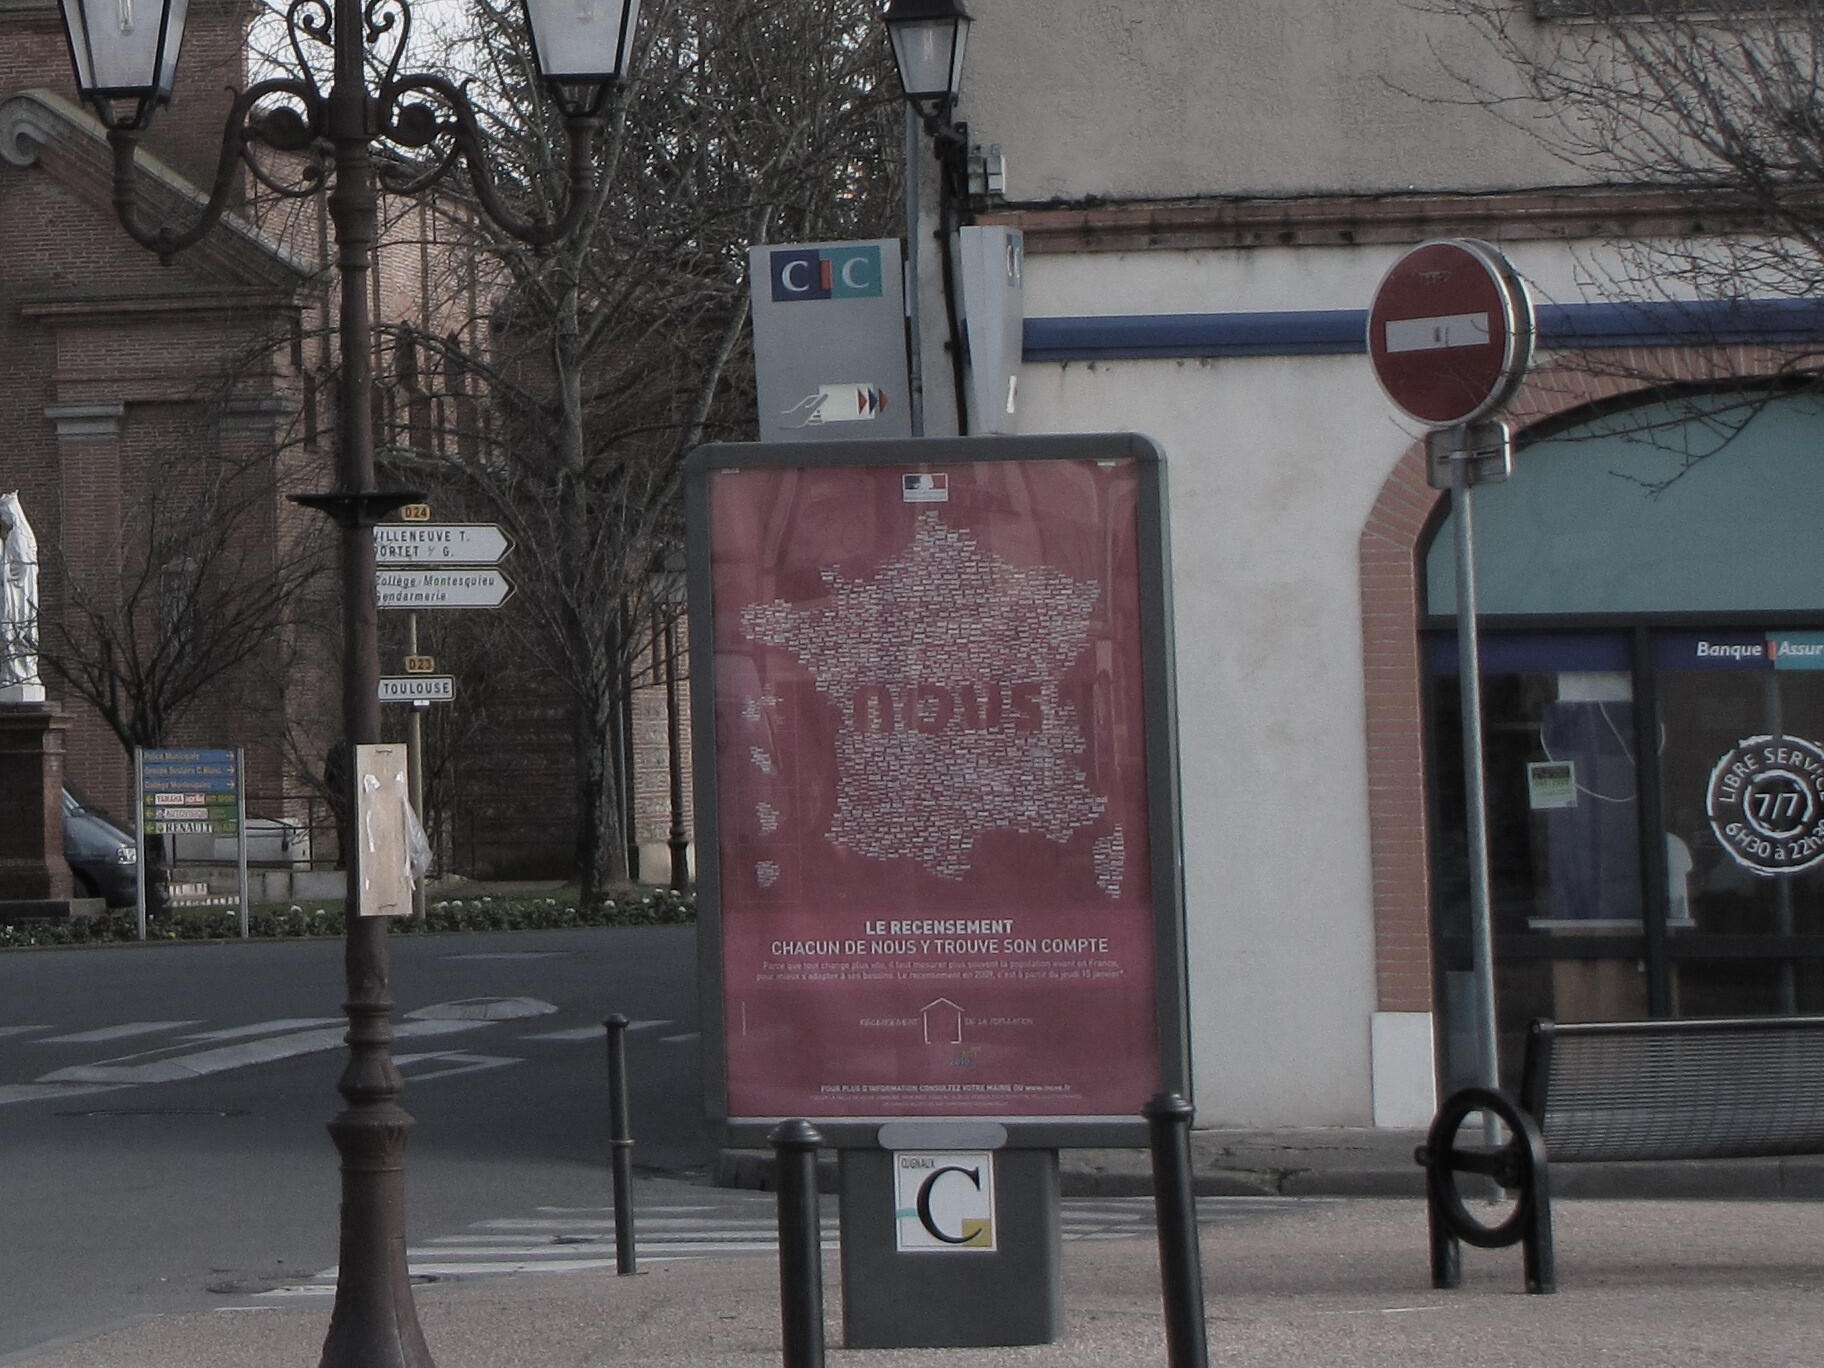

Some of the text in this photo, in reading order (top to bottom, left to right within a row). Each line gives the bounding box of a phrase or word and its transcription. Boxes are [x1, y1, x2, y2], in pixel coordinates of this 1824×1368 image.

[781, 256, 870, 292] CIC
[374, 531, 452, 543] VILLENEUVE
[423, 573, 495, 588] Montesquieu
[376, 589, 447, 602] Gendarmerie
[1696, 640, 1763, 658] Banque
[383, 682, 450, 694] TOULOUSE
[1719, 753, 1760, 803] LIBRE
[1755, 793, 1799, 820] 7/7
[166, 823, 212, 832] RENAULT
[1725, 822, 1771, 857] 6H30
[1774, 844, 1785, 860] à
[865, 919, 1014, 935] LE RECENSEMENT
[771, 938, 1109, 955] CHACUN DE NOUS Y TROUVE SON COMPTE
[916, 1165, 983, 1244] C
